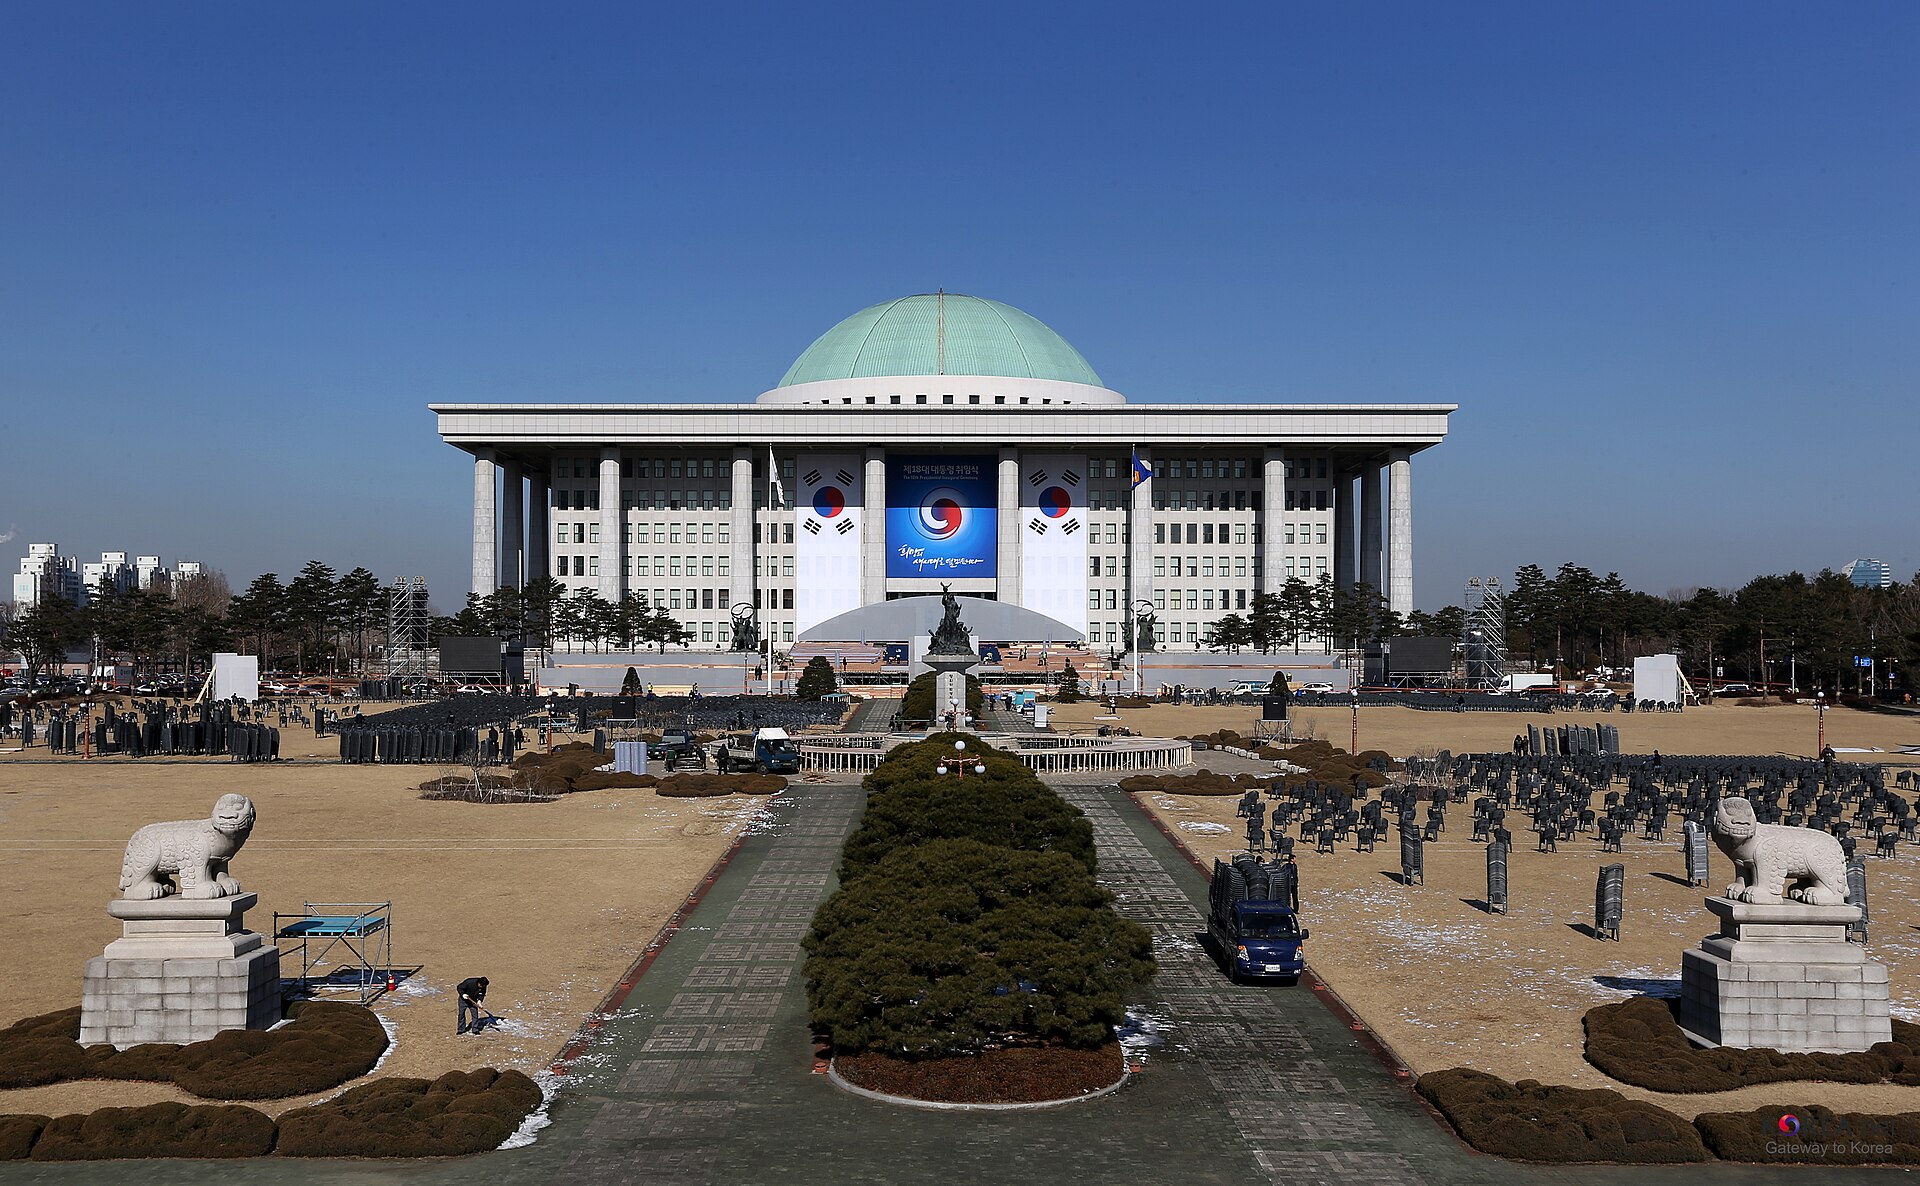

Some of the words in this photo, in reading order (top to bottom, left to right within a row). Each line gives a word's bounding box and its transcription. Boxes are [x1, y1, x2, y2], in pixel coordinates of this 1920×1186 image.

[903, 465, 930, 475] 제18대
[930, 465, 955, 475] 대통령
[955, 465, 979, 475] 취임식
